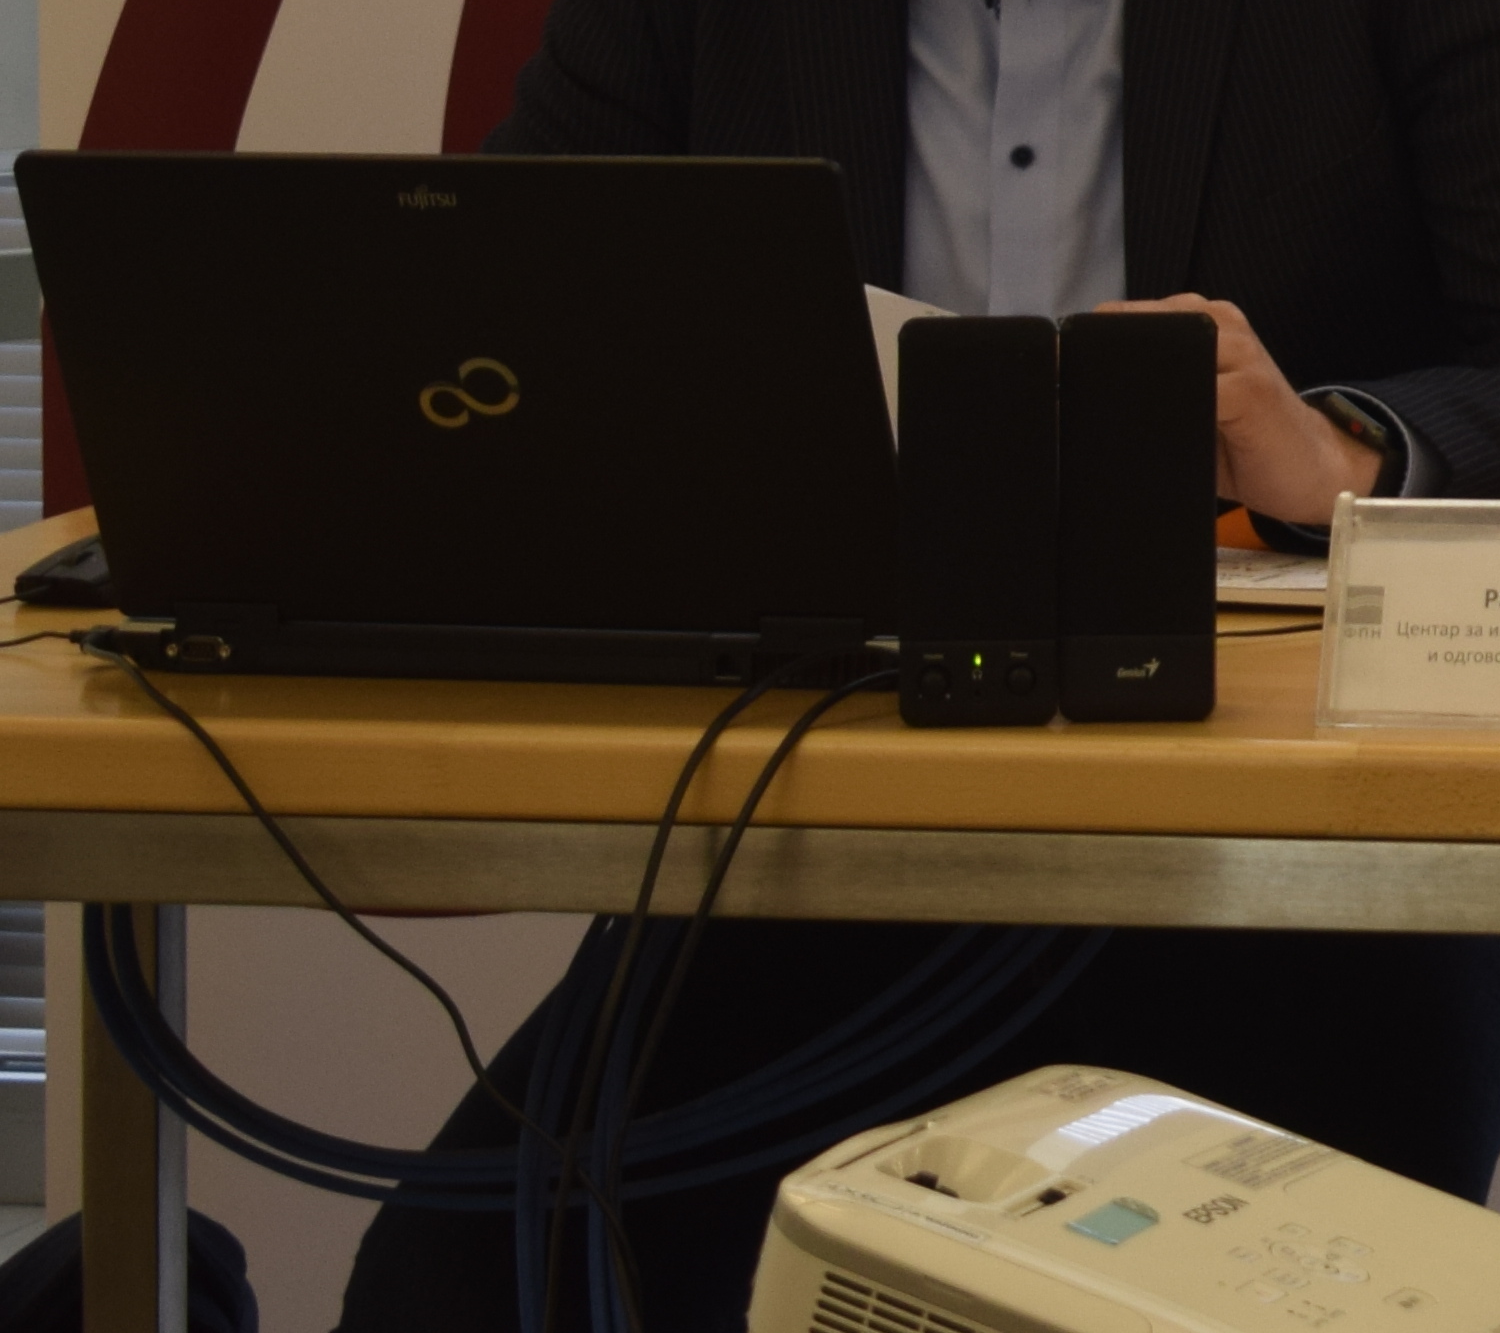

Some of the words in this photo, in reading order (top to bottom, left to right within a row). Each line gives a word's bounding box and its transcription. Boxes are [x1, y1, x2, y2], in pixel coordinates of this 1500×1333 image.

[398, 185, 457, 209] FUJITSU
[1397, 622, 1460, 642] Центар
[1465, 625, 1483, 637] за
[1428, 652, 1438, 663] и
[1182, 1194, 1250, 1224] EPSON
